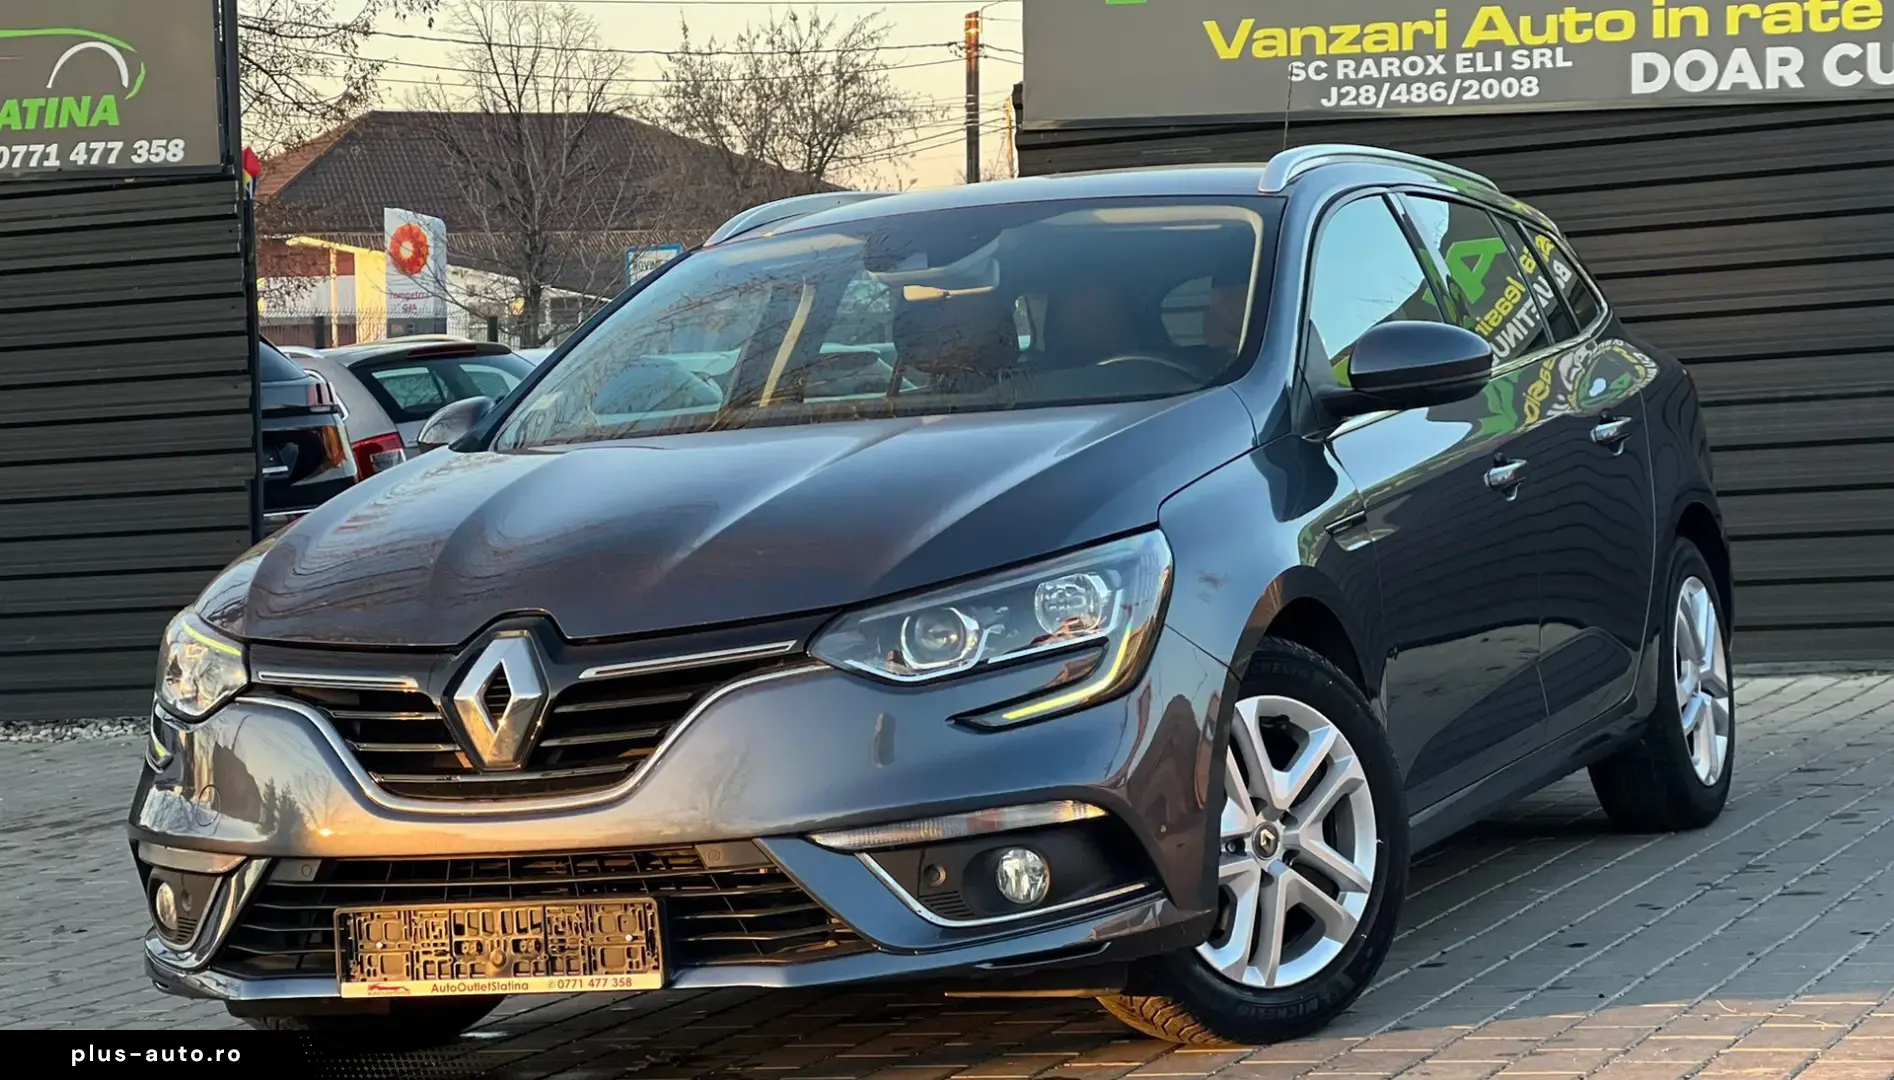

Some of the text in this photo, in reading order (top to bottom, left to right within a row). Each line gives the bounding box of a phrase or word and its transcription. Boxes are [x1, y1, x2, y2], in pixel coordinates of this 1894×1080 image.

[1202, 0, 1883, 59] Vanzari Auto in rate
[1288, 47, 1573, 81] SC RAROX ELI SRL
[1631, 42, 1894, 94] DOAR CU
[1320, 76, 1540, 108] J28/486/2008
[69, 141, 124, 165] 477
[130, 139, 185, 163] 358
[431, 977, 632, 993] AutoOutletSlatina 0771 477 358
